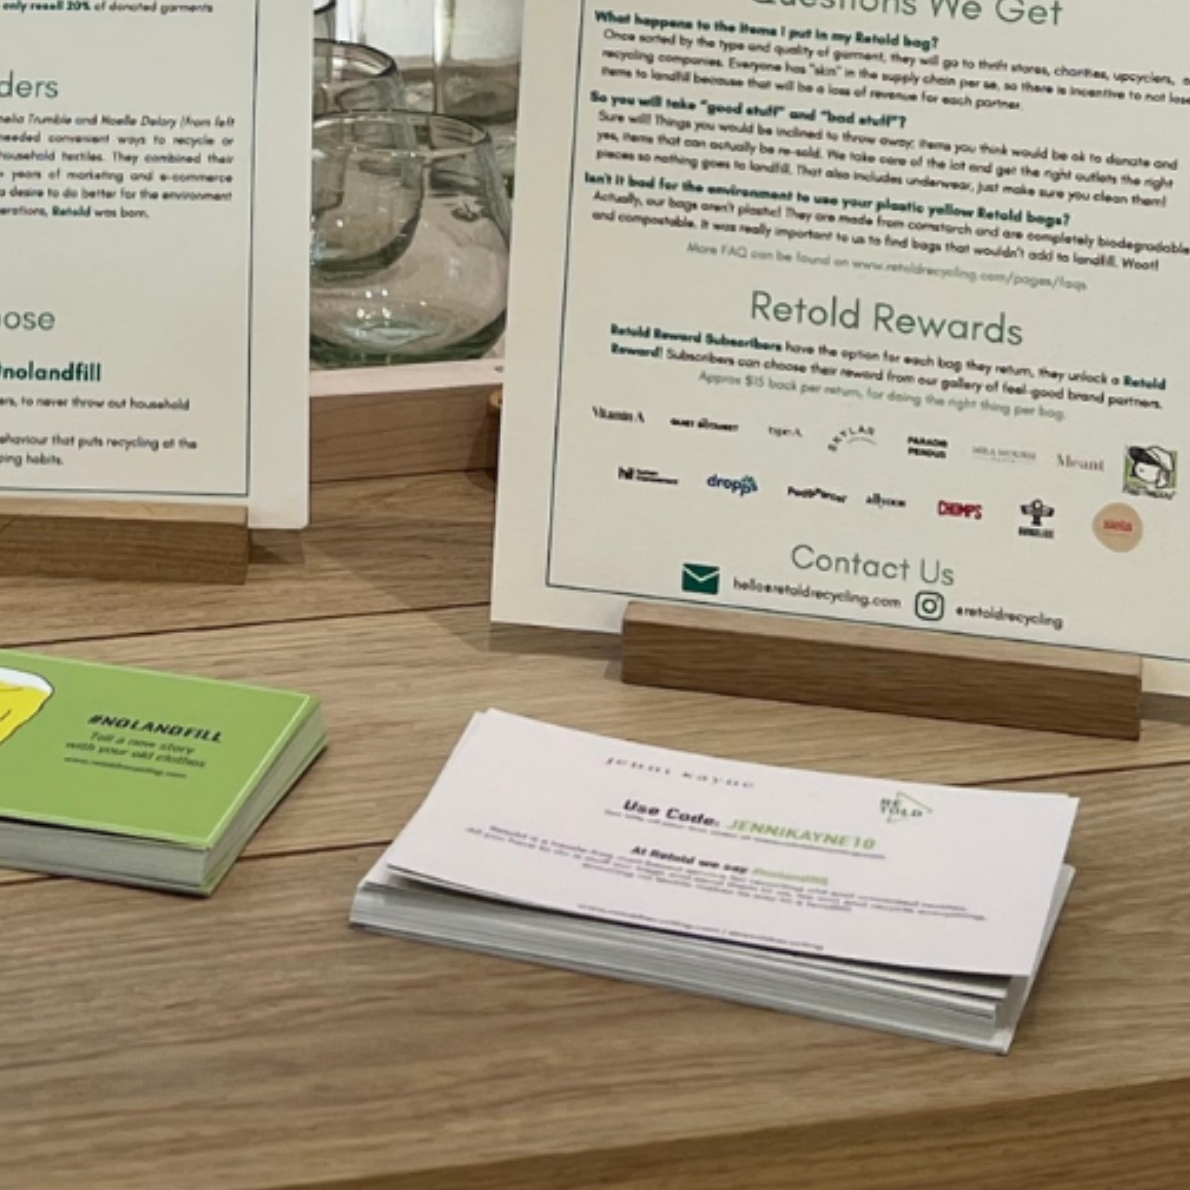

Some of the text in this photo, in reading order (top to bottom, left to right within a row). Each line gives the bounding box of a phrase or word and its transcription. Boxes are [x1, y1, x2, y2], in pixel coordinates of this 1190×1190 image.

[3, 0, 27, 13] only
[30, 0, 64, 10] resell
[67, 0, 90, 10] 20%
[94, 0, 106, 11] of
[109, 0, 157, 12] donated
[160, 3, 213, 15] garments
[595, 10, 631, 24] What
[634, 12, 693, 30] happens
[697, 19, 710, 30] to
[714, 20, 736, 33] the
[789, 28, 812, 40] put
[815, 28, 828, 40] in
[831, 32, 851, 45] my
[855, 30, 899, 46] Retold
[903, 34, 939, 52] bag?
[590, 89, 607, 102] So
[611, 95, 635, 107] you
[638, 95, 662, 107] will
[666, 97, 696, 110] take
[789, 108, 816, 121] and
[615, 174, 624, 185] it
[628, 175, 655, 189] bad
[659, 176, 678, 190] for
[682, 179, 703, 192] the
[707, 184, 793, 200] environment
[797, 191, 810, 203] to
[814, 196, 838, 206] use
[842, 198, 872, 209] your
[876, 197, 924, 213] plastic
[928, 203, 974, 217] yellow
[977, 206, 1022, 222] Retold
[1026, 210, 1070, 228] bags?
[751, 290, 1023, 345] Retold Rewards
[791, 544, 955, 587] Contact Us
[87, 714, 223, 743] #NOLANDFILL
[159, 742, 196, 755] story
[623, 799, 660, 817] Use
[665, 808, 721, 827] Code:
[726, 819, 877, 850] JENNIKAYNE10
